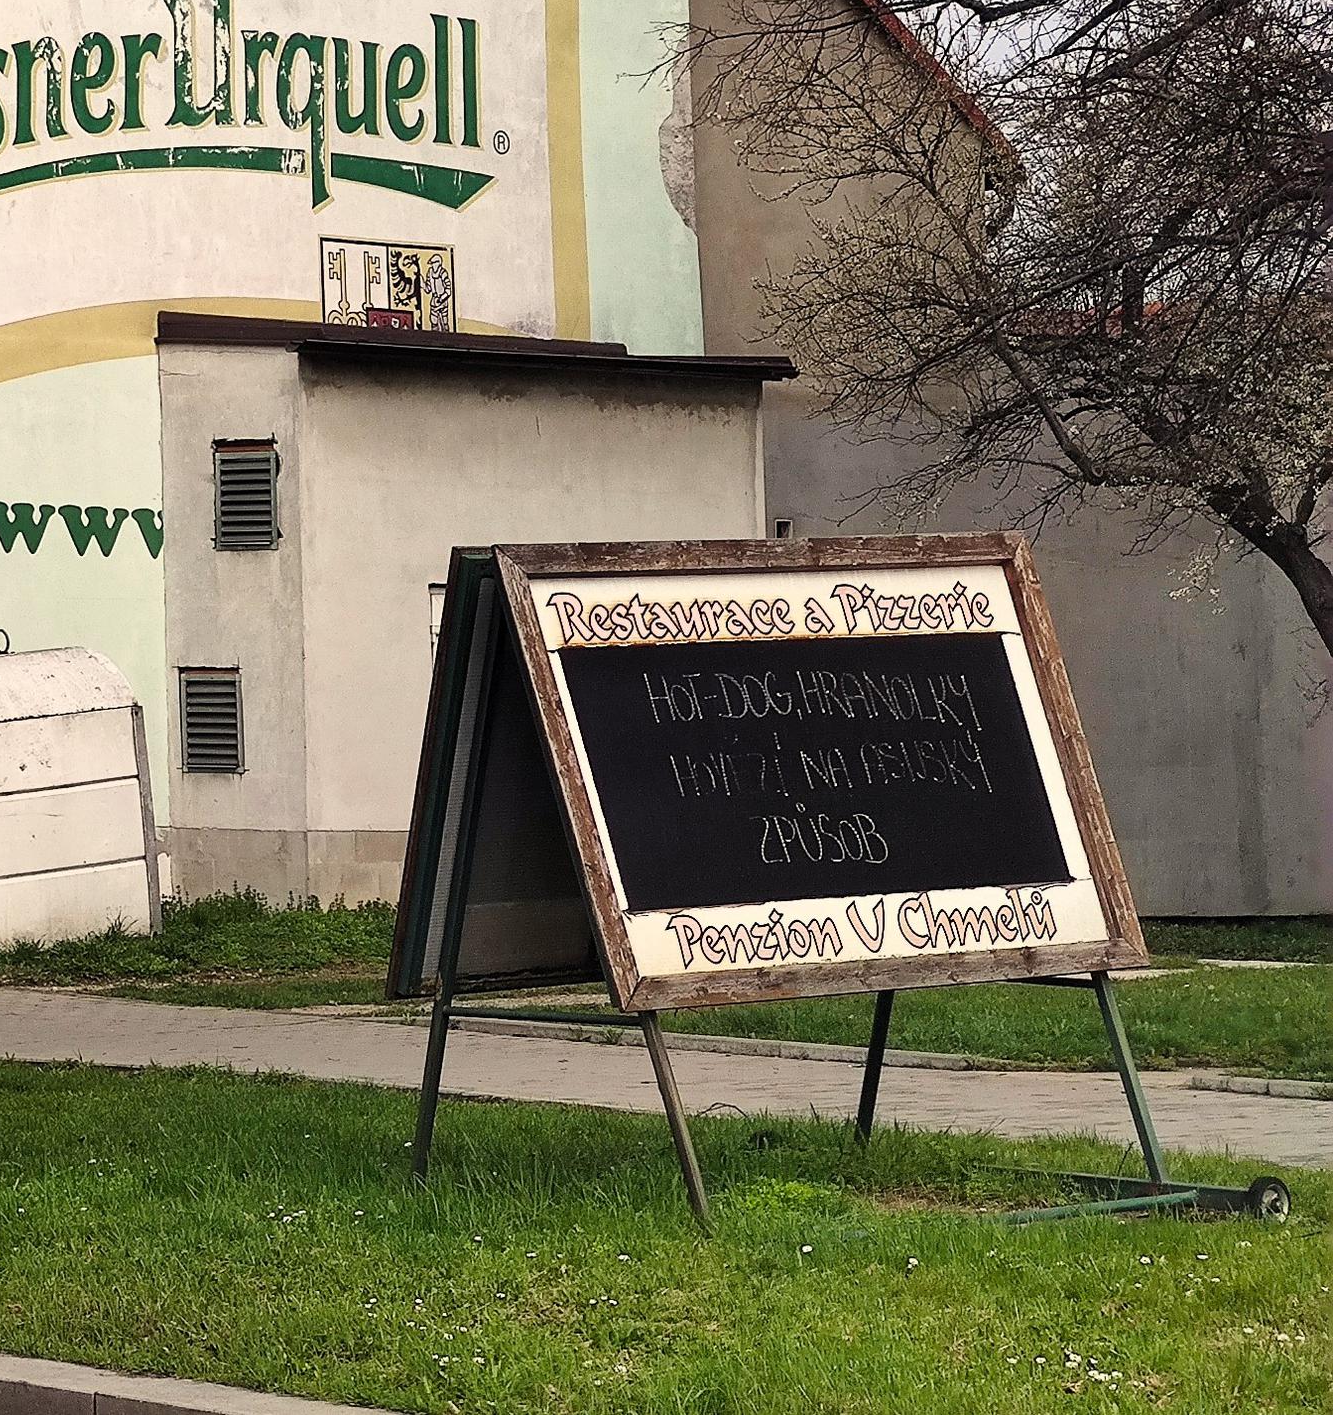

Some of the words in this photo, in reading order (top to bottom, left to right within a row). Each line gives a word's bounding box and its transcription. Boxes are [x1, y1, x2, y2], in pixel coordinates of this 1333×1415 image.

[545, 591, 796, 645] Restaurace
[804, 597, 835, 635] a
[830, 581, 995, 635] Pizzerie
[800, 747, 853, 791] NA
[665, 908, 843, 970] Penzion
[898, 888, 1058, 949] Chmelů
